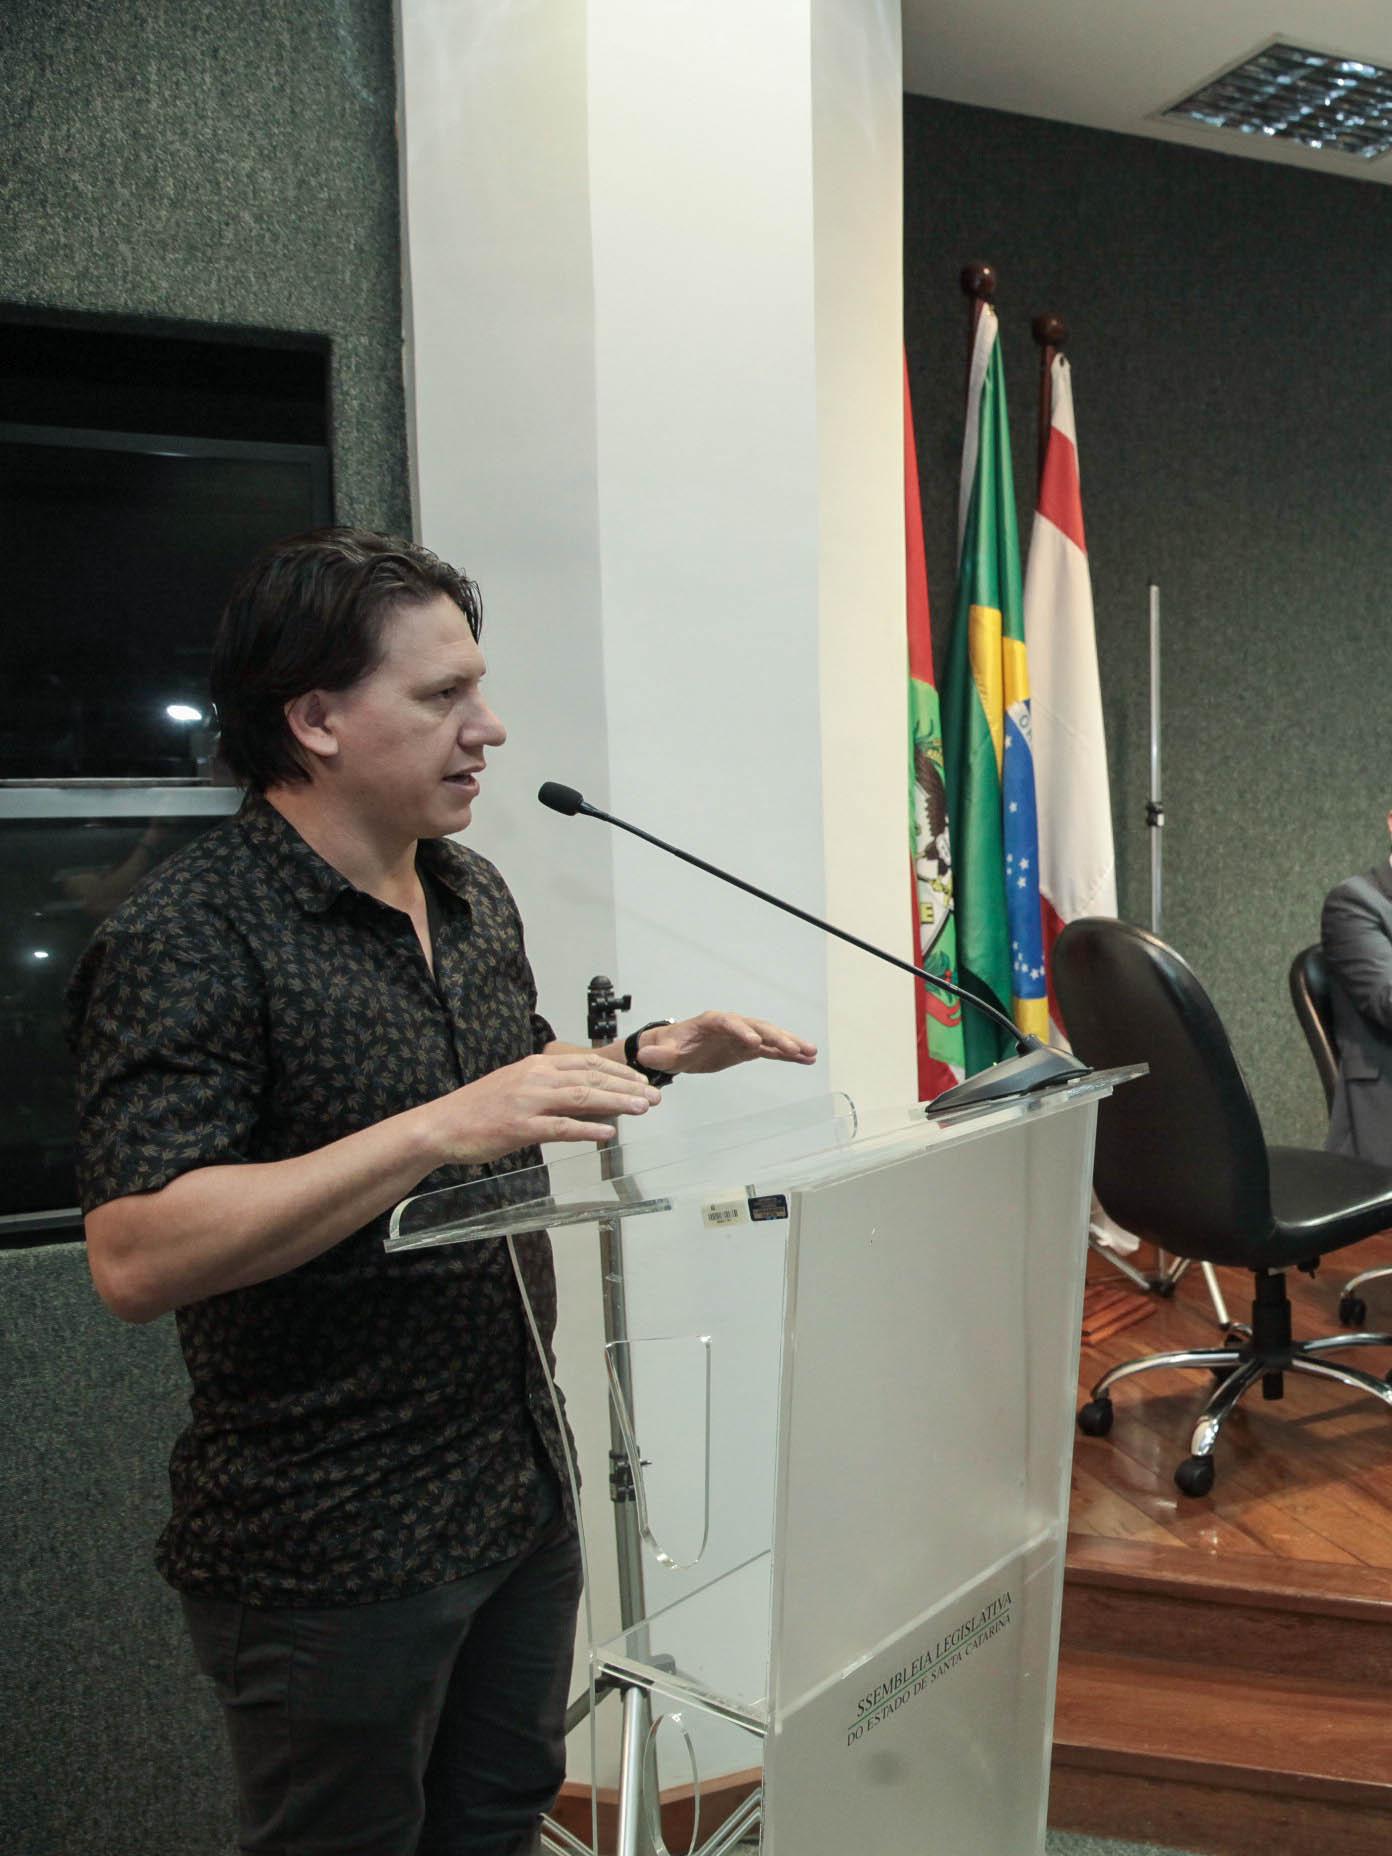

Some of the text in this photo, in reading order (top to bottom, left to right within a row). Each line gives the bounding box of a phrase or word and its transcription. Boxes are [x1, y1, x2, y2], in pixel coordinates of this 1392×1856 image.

[936, 1591, 1012, 1659] LEGISLATIVA
[847, 1613, 1011, 1747] DO ESTADO DE SANTA CATARINA
